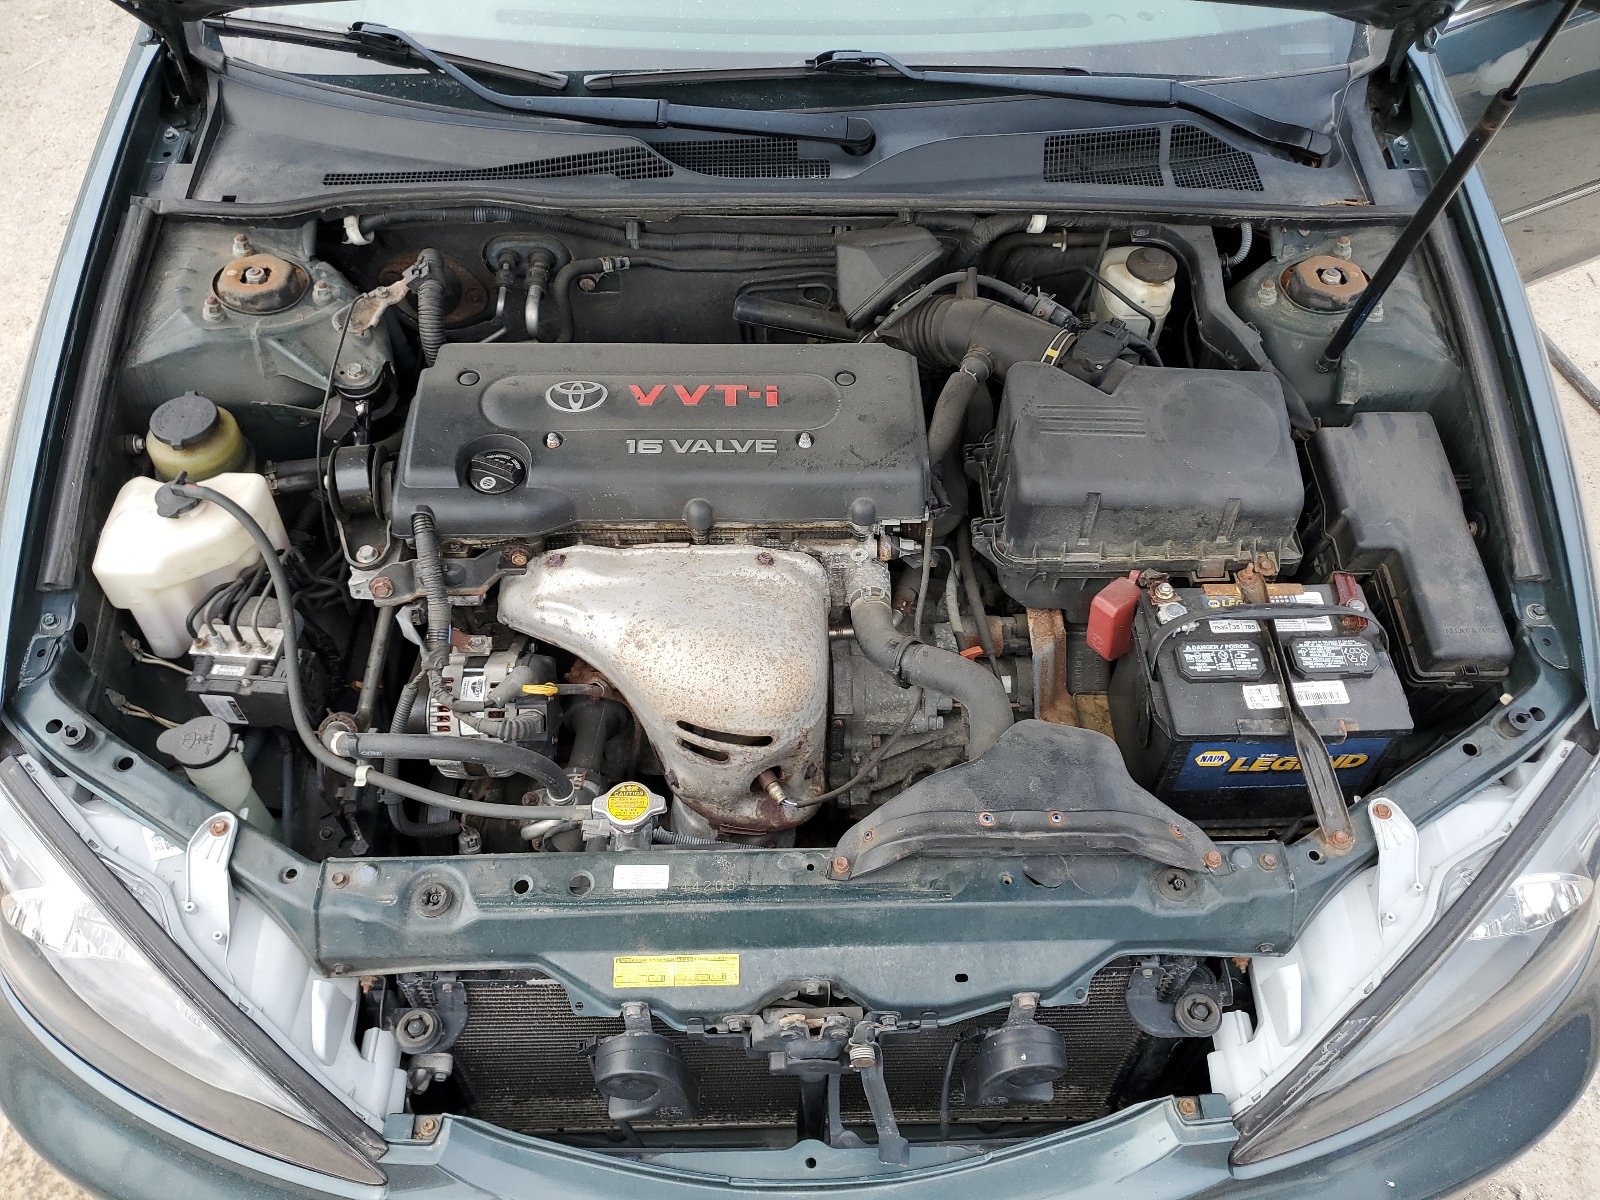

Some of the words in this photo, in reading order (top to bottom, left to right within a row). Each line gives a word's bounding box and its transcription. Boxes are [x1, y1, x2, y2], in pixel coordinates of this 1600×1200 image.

[627, 384, 779, 407] VVT-i
[626, 439, 664, 454] 16
[668, 439, 779, 455] VALVE
[1477, 626, 1499, 634] FUSE
[1200, 754, 1226, 763] NAPA
[1227, 754, 1370, 773] LEGND
